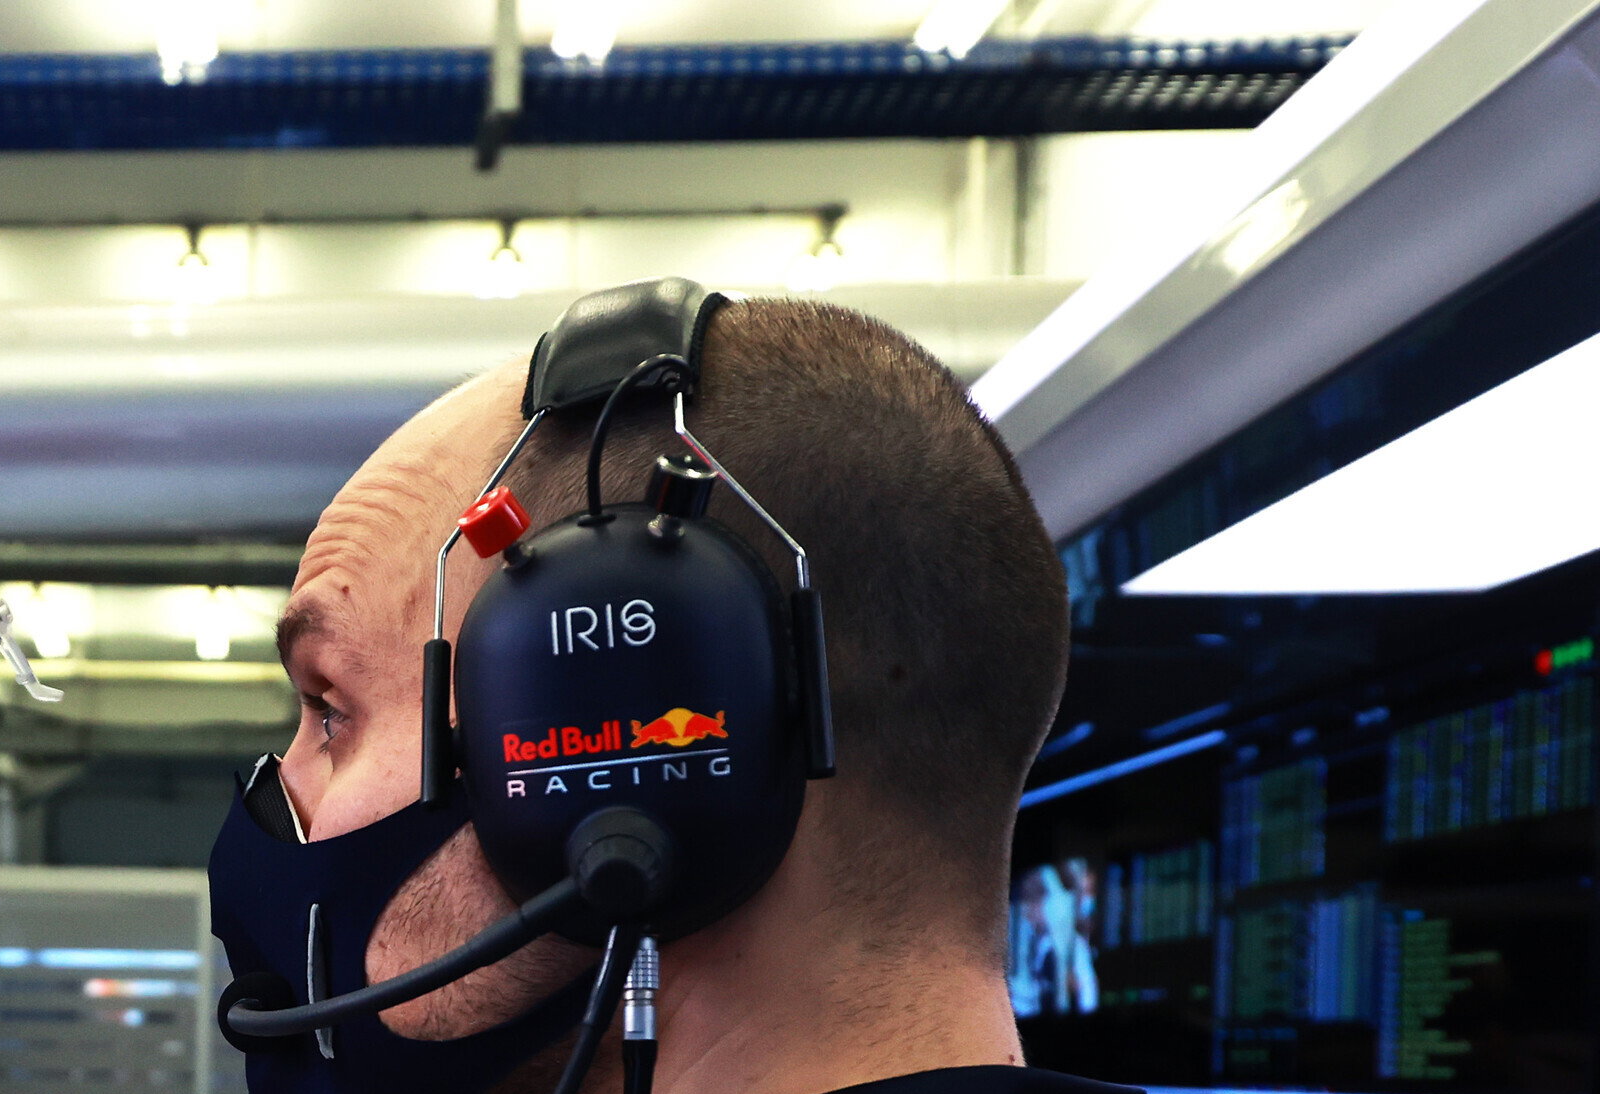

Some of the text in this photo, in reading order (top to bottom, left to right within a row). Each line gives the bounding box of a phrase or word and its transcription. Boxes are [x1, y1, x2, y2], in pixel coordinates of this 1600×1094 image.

[551, 599, 657, 656] IRIS
[502, 720, 622, 763] Red Bull
[506, 756, 732, 799] RACING
